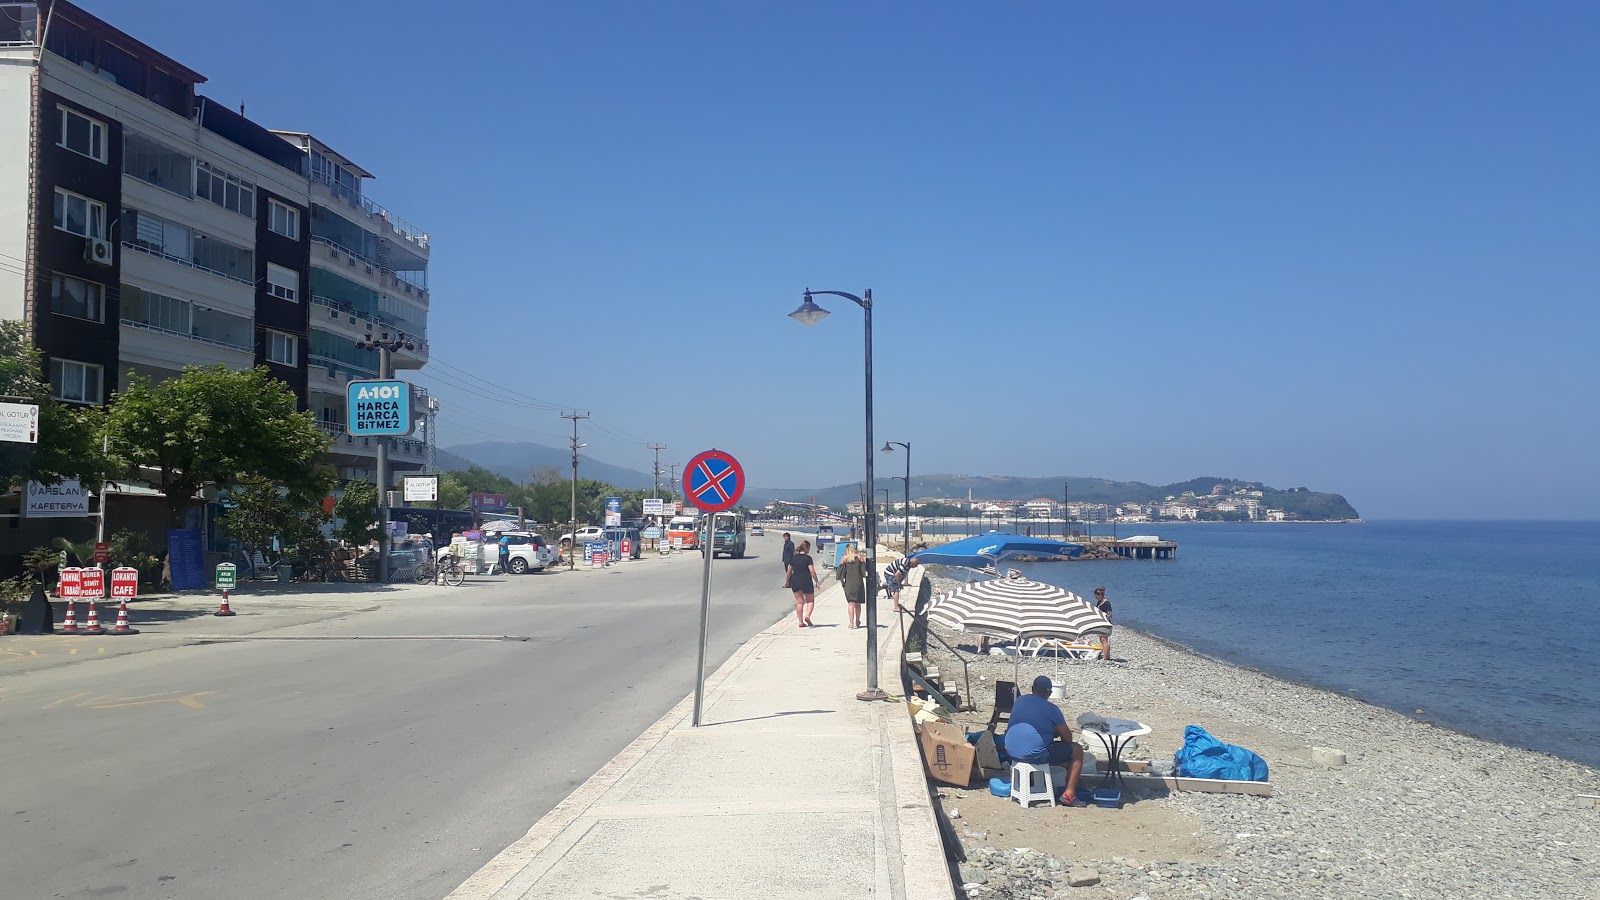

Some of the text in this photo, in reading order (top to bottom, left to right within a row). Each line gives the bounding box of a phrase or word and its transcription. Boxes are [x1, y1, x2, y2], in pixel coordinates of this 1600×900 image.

[358, 402, 399, 410] HARCA
[358, 411, 399, 420] HARCA
[38, 487, 80, 496] ARSLAN
[31, 502, 84, 510] KAFETERYA
[62, 572, 80, 582] KAHVAL
[113, 572, 137, 581] LOKANTA
[84, 579, 100, 587] SİMİT
[81, 588, 103, 597] POĞAÇA
[113, 585, 134, 595] CAFE
